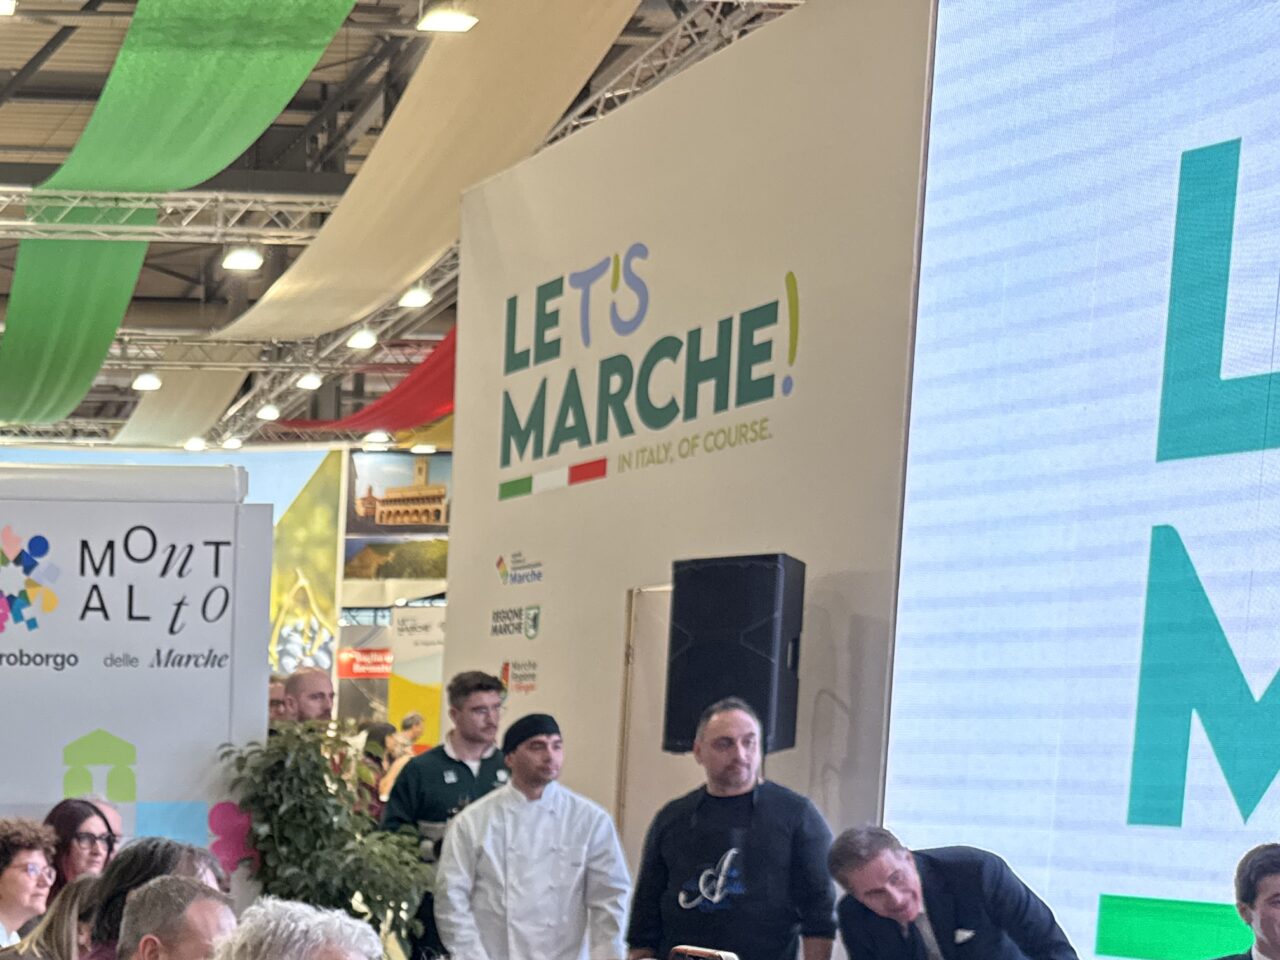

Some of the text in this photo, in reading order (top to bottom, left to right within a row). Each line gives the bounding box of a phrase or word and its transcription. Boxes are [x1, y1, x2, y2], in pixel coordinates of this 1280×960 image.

[503, 242, 650, 377] LET'S
[499, 270, 800, 469] MARCHE!
[617, 417, 773, 473] IN ITALY, OF COURSE.
[509, 570, 543, 585] Marche
[492, 607, 524, 623] REGIONE
[490, 621, 524, 637] MARCHE
[103, 651, 140, 668] delle
[148, 649, 230, 669] Marche
